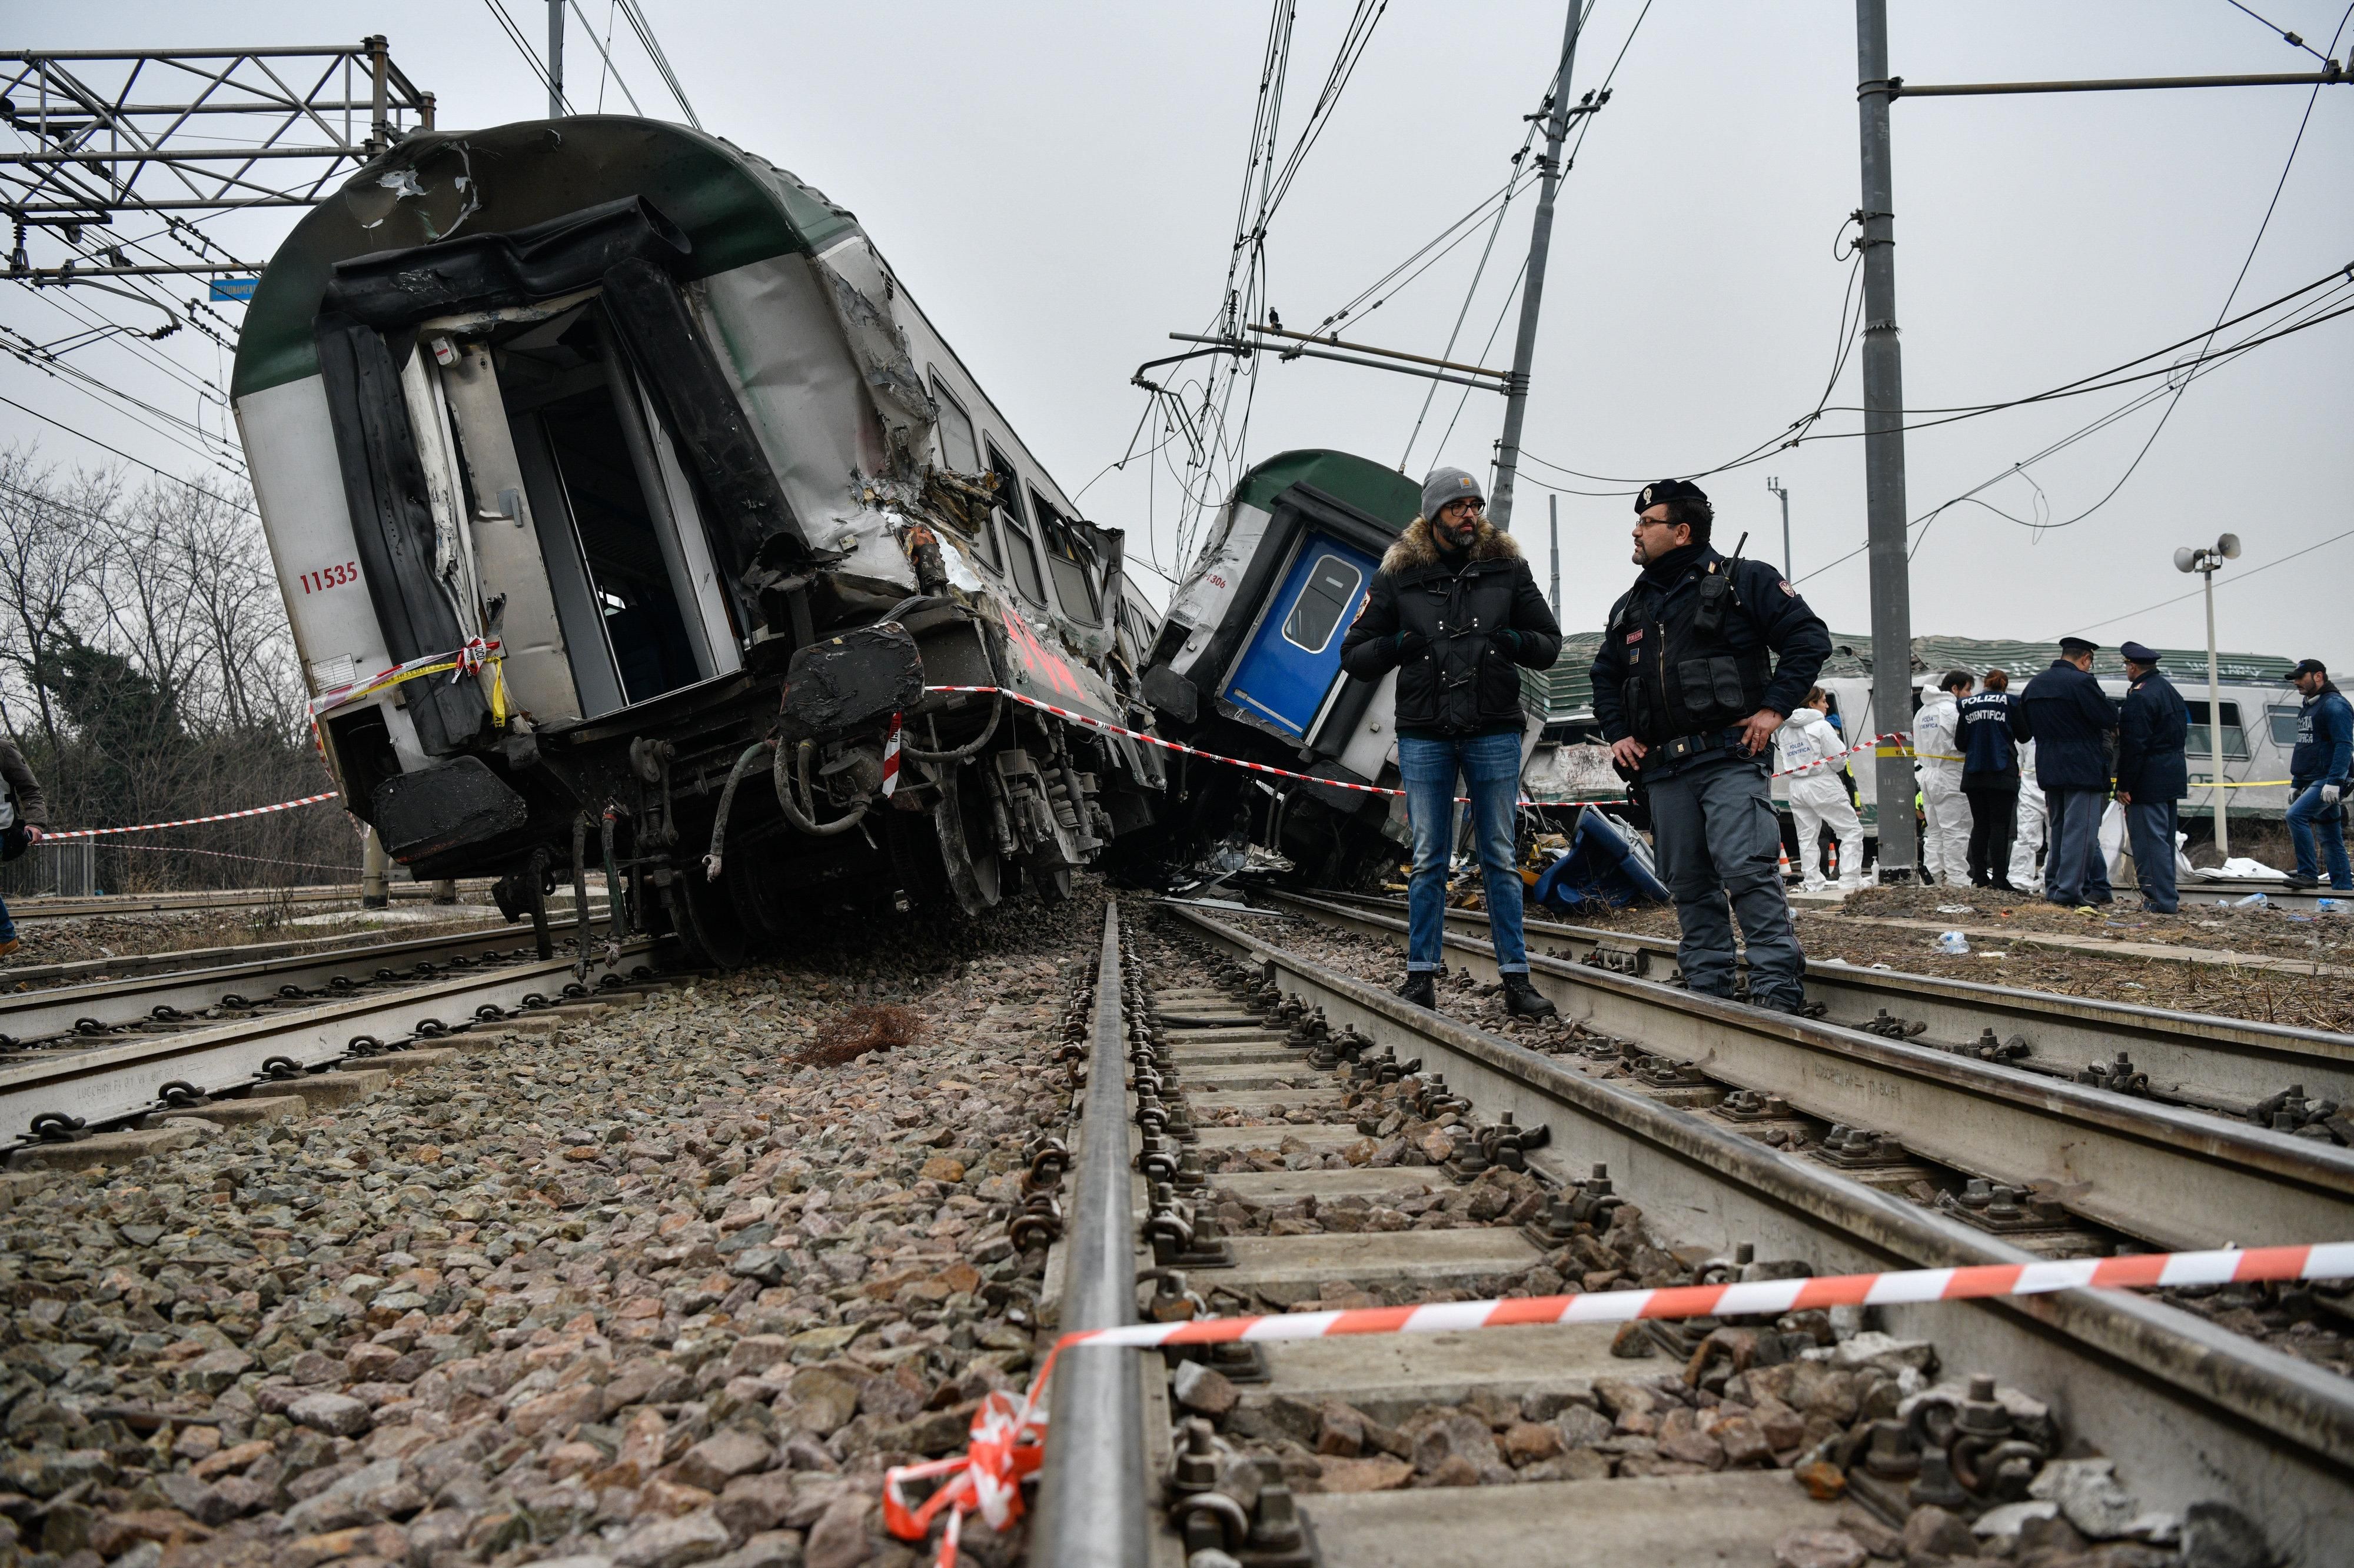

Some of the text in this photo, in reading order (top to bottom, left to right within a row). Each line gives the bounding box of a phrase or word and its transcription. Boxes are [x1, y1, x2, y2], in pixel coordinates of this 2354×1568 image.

[215, 284, 257, 295] SEZIONAMENT
[300, 561, 357, 594] 11535
[1628, 632, 1641, 642] POLIZIA
[1961, 695, 2007, 708] POLIZIA
[1965, 710, 2006, 724] SCIENTIFICA
[1787, 747, 1810, 757] SCIENTIFICA
